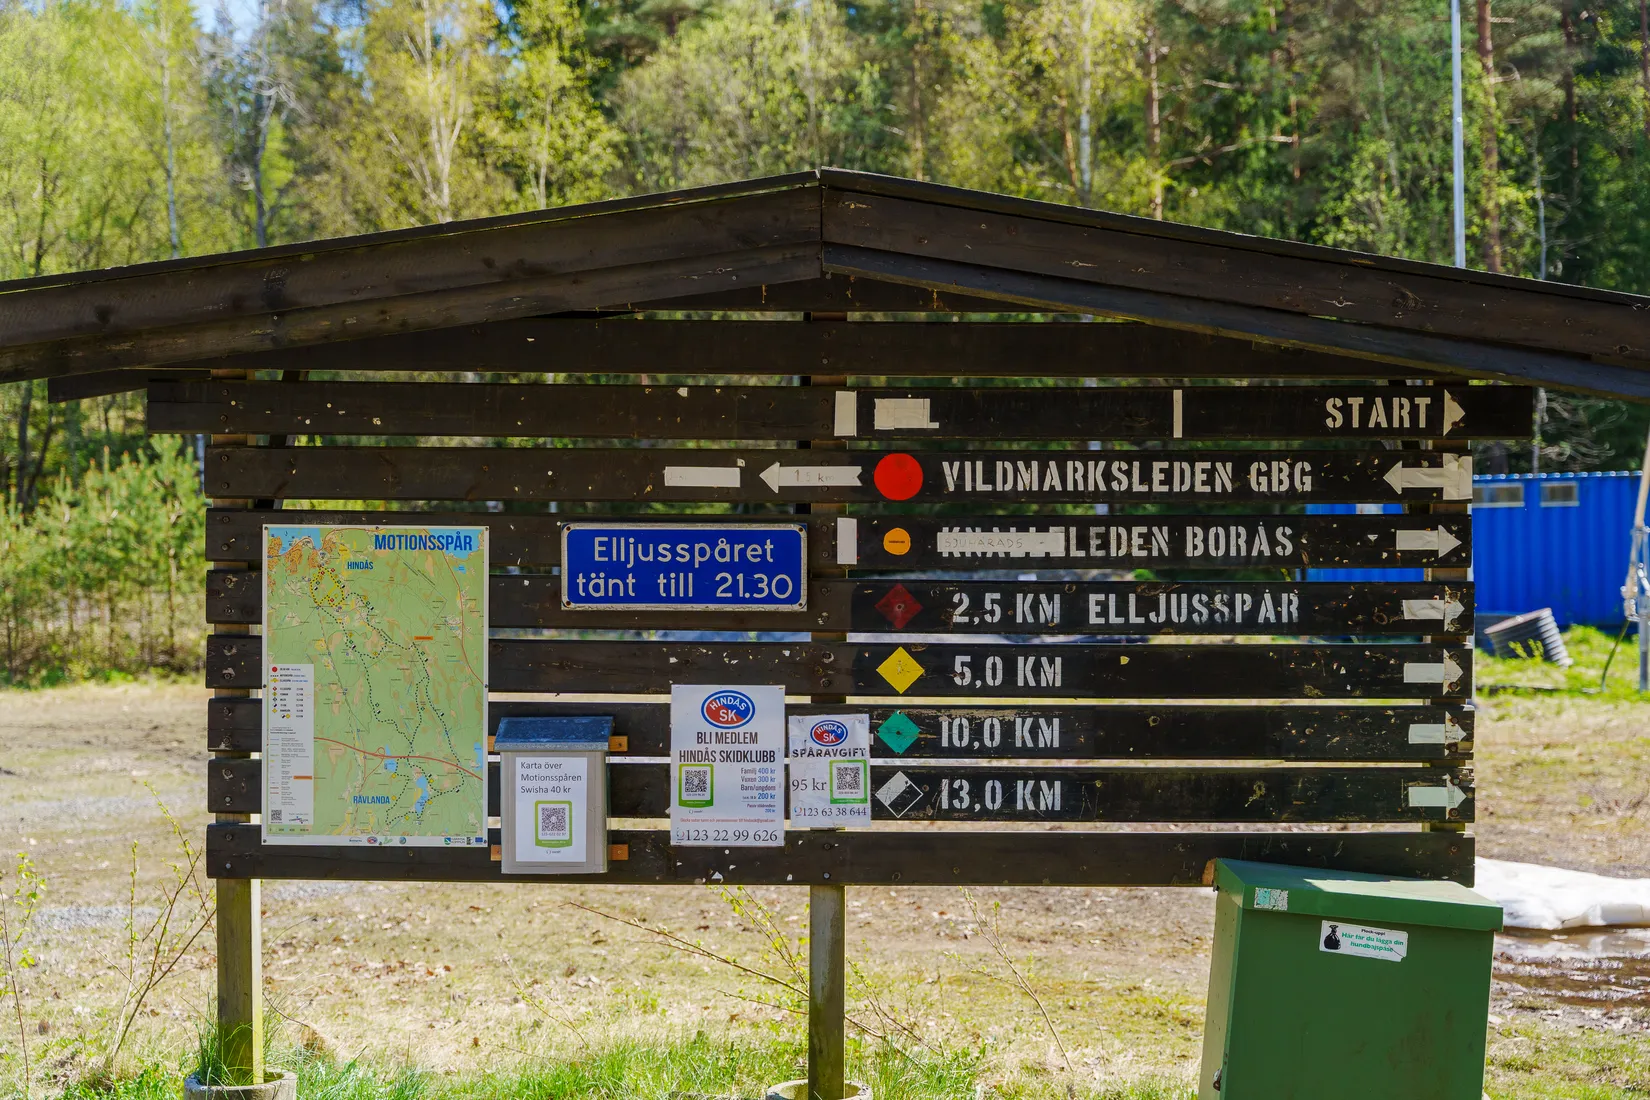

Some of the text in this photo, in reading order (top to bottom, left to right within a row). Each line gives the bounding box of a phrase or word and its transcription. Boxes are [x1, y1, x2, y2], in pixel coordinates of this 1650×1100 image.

[1325, 397, 1431, 428] START
[942, 461, 1312, 492] VILDMARKSLEDEN GBG
[374, 531, 473, 551] MOTIONSSPÅR
[1185, 521, 1294, 557] BORÅS
[593, 537, 774, 568] Elljusspåret
[347, 561, 374, 570] HINDÅS
[576, 572, 793, 599] tänt till 21.30
[952, 589, 1299, 625] 2,5 KM ELLJUSSPÅR
[953, 655, 1062, 688] 5,0 KM
[709, 696, 747, 711] HINDÅS
[719, 709, 737, 721] SK
[815, 724, 843, 735] HINDÅS
[941, 717, 1060, 749] 10,0 KM
[696, 731, 758, 744] BLI MEDLEM
[823, 733, 836, 742] SK
[679, 747, 776, 763] HINDÅS SKIDKLUBB
[792, 747, 866, 758] SPÅRAVGIFT
[740, 767, 757, 775] Familj
[520, 774, 582, 783] Motionsspåren
[791, 778, 827, 791] 95 kr
[520, 786, 572, 794] Swisha 40 kr
[941, 779, 1061, 812] 13,0 KM
[803, 807, 867, 817] 123 63 38 644
[686, 829, 778, 841] 123 22 99 626
